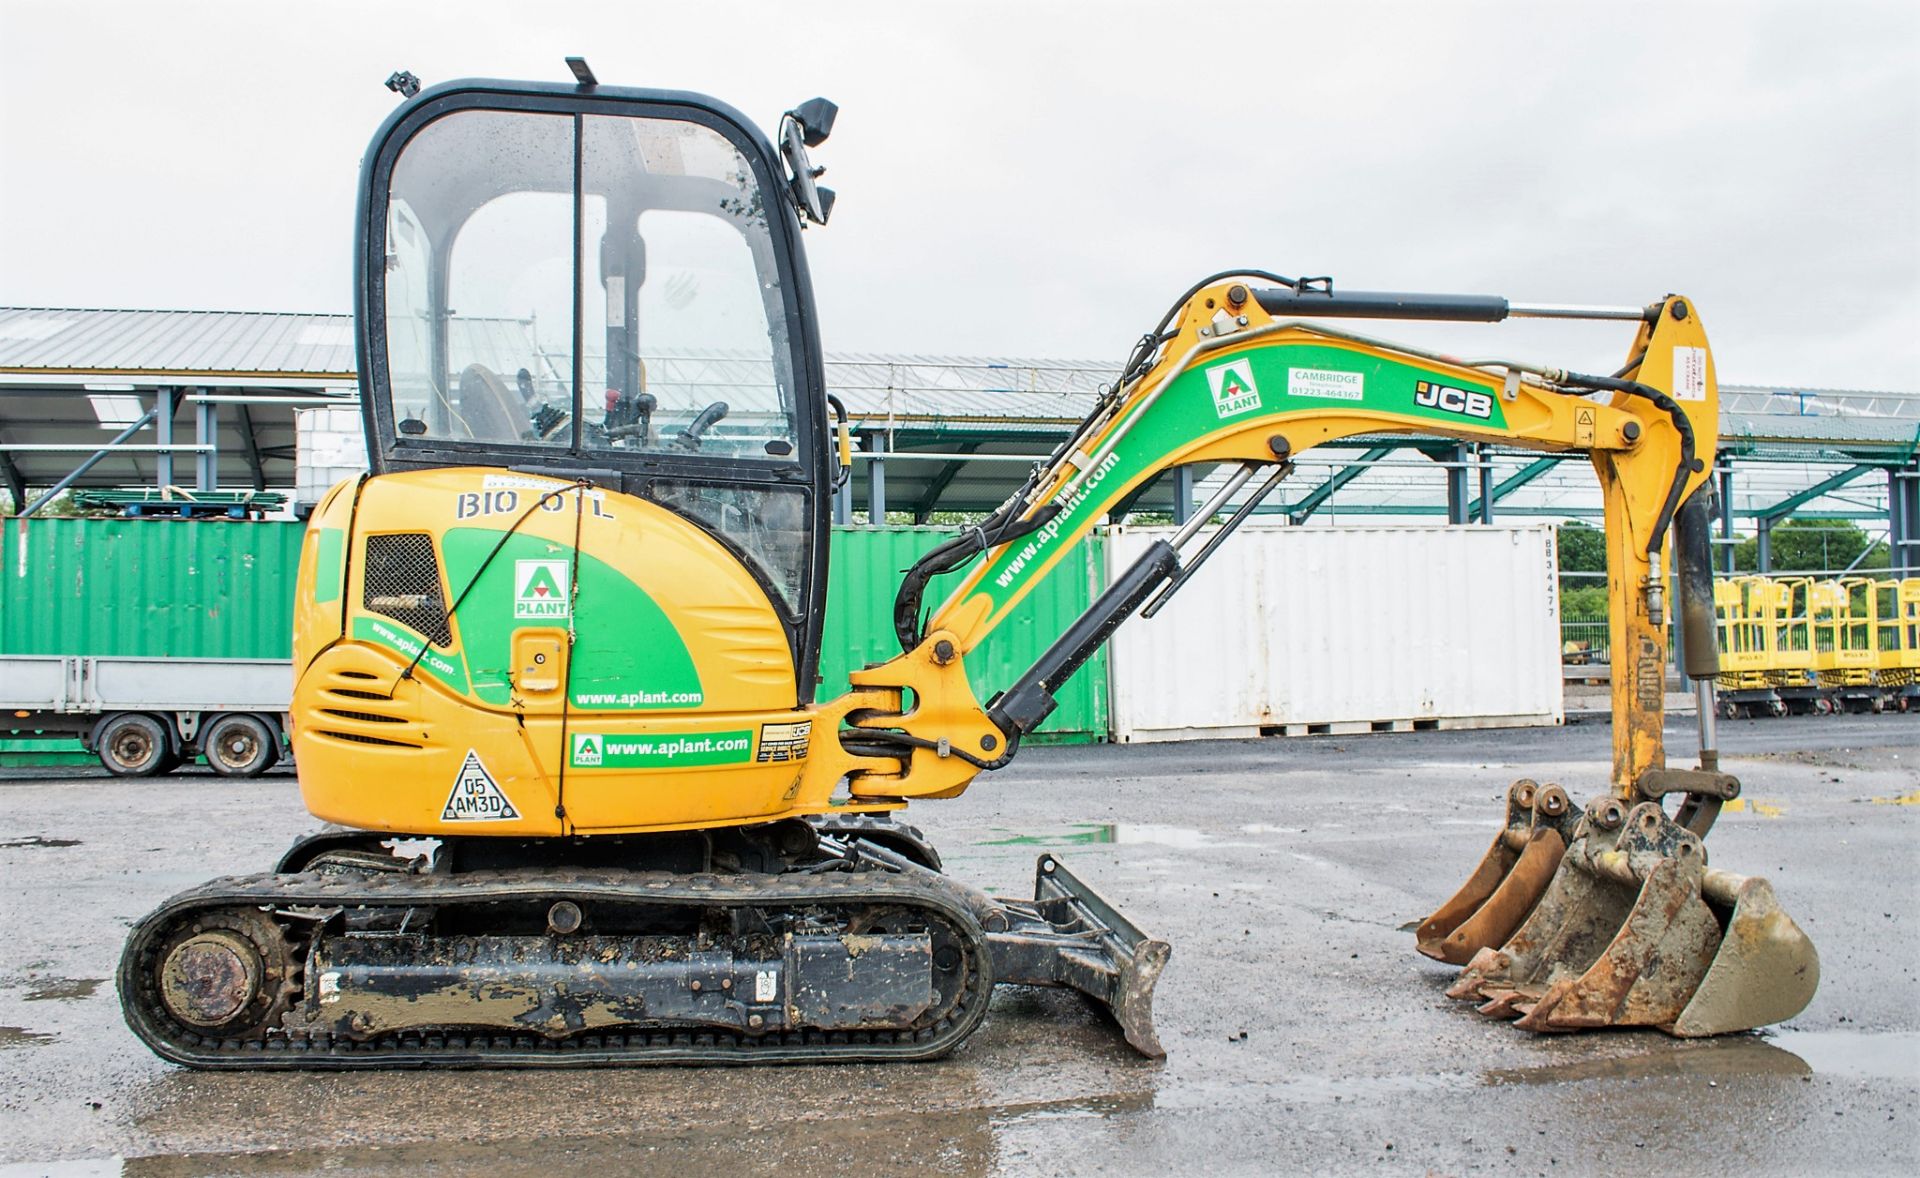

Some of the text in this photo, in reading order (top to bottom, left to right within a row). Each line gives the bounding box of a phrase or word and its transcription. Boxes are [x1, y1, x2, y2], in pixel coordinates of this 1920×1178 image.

[1295, 371, 1358, 384] CAMBRIDGE
[1218, 395, 1257, 414] PLANT
[1416, 381, 1492, 418] JCB
[457, 491, 518, 518] BIO
[516, 603, 566, 614] PLANT
[576, 690, 702, 707] www.aplant.com
[606, 738, 749, 758] www.aplant.com
[456, 796, 501, 813] AM3D
